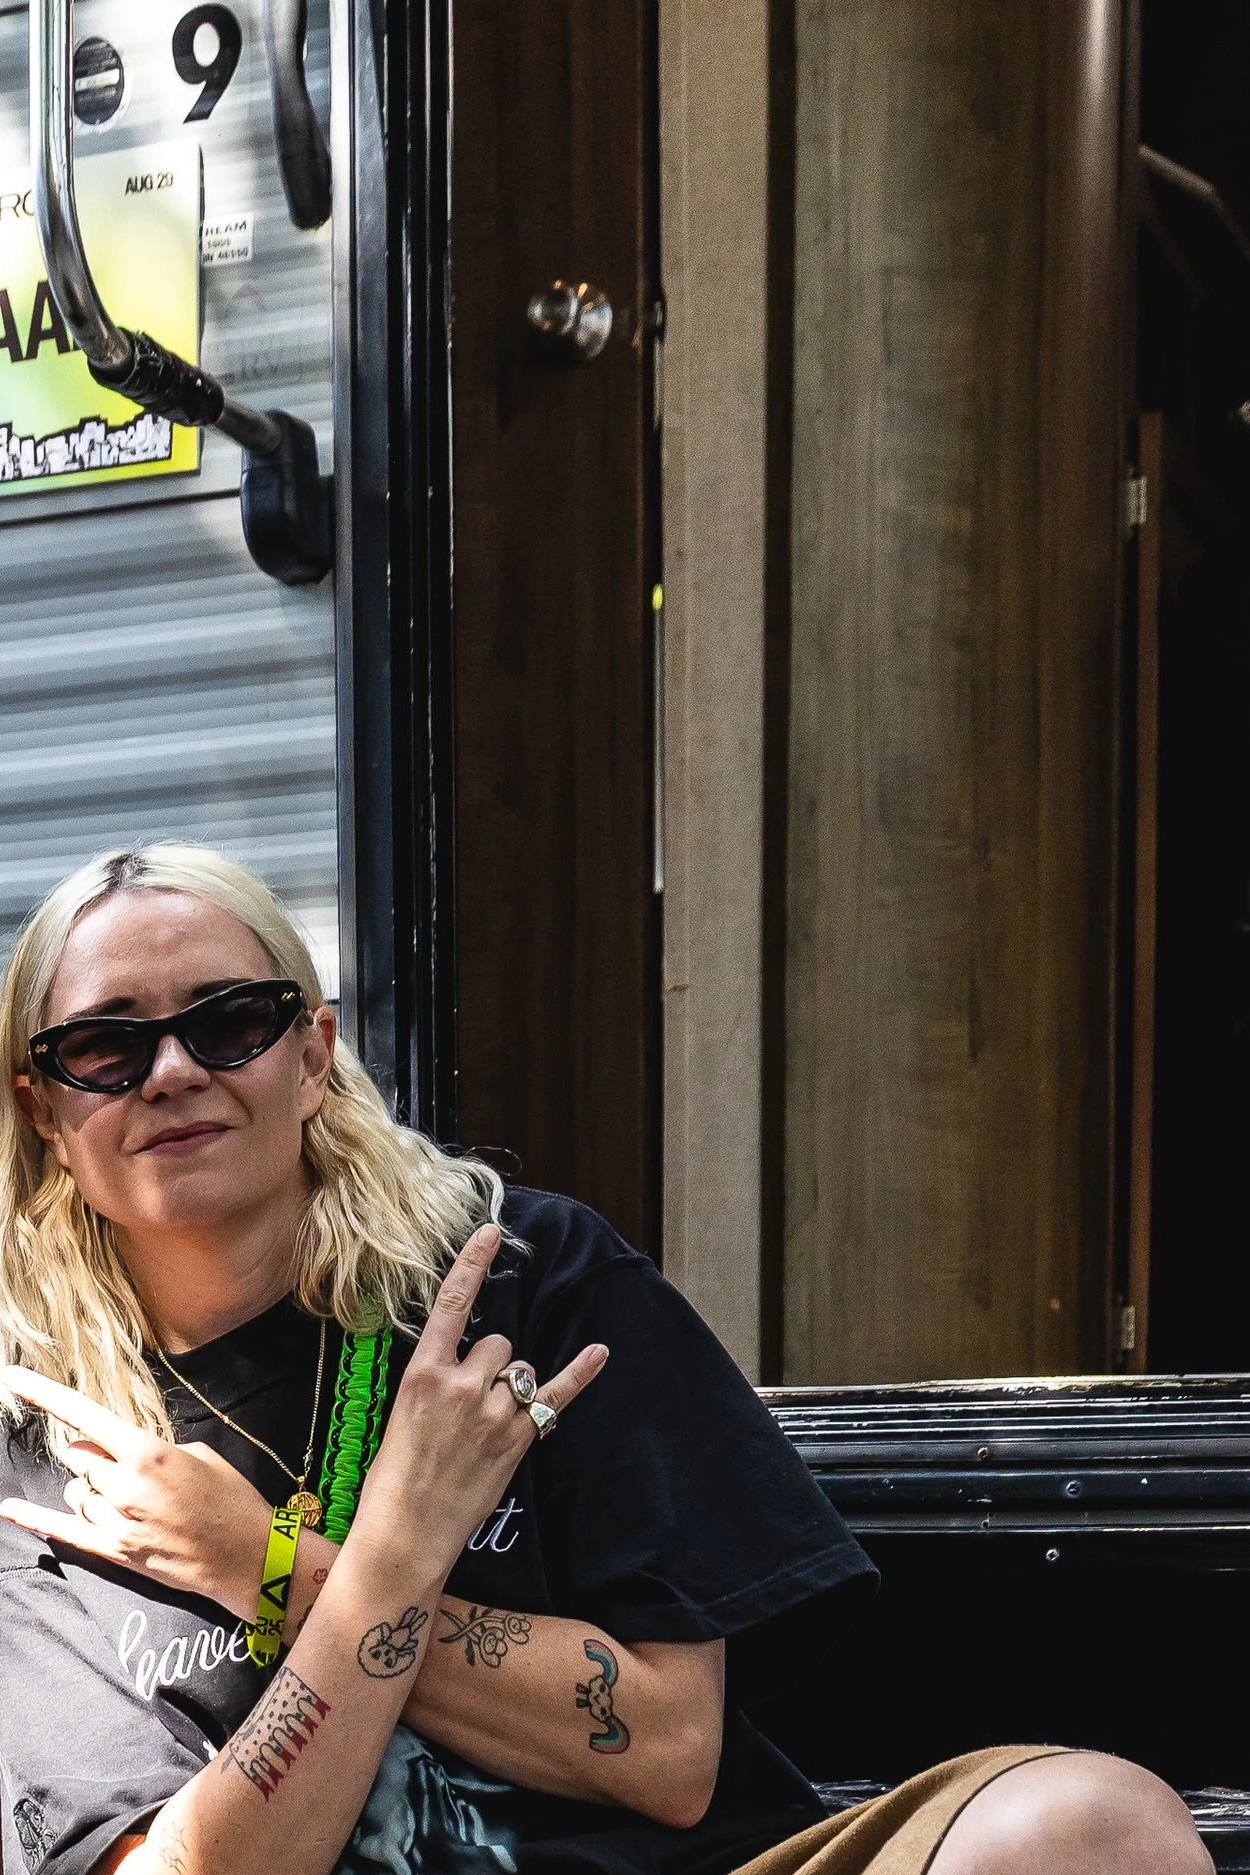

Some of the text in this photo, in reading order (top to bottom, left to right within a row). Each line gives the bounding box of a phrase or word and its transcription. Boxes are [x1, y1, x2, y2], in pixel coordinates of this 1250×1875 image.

[171, 2, 243, 124] 9
[125, 171, 175, 196] AUG 29
[273, 1509, 300, 1541] AR
